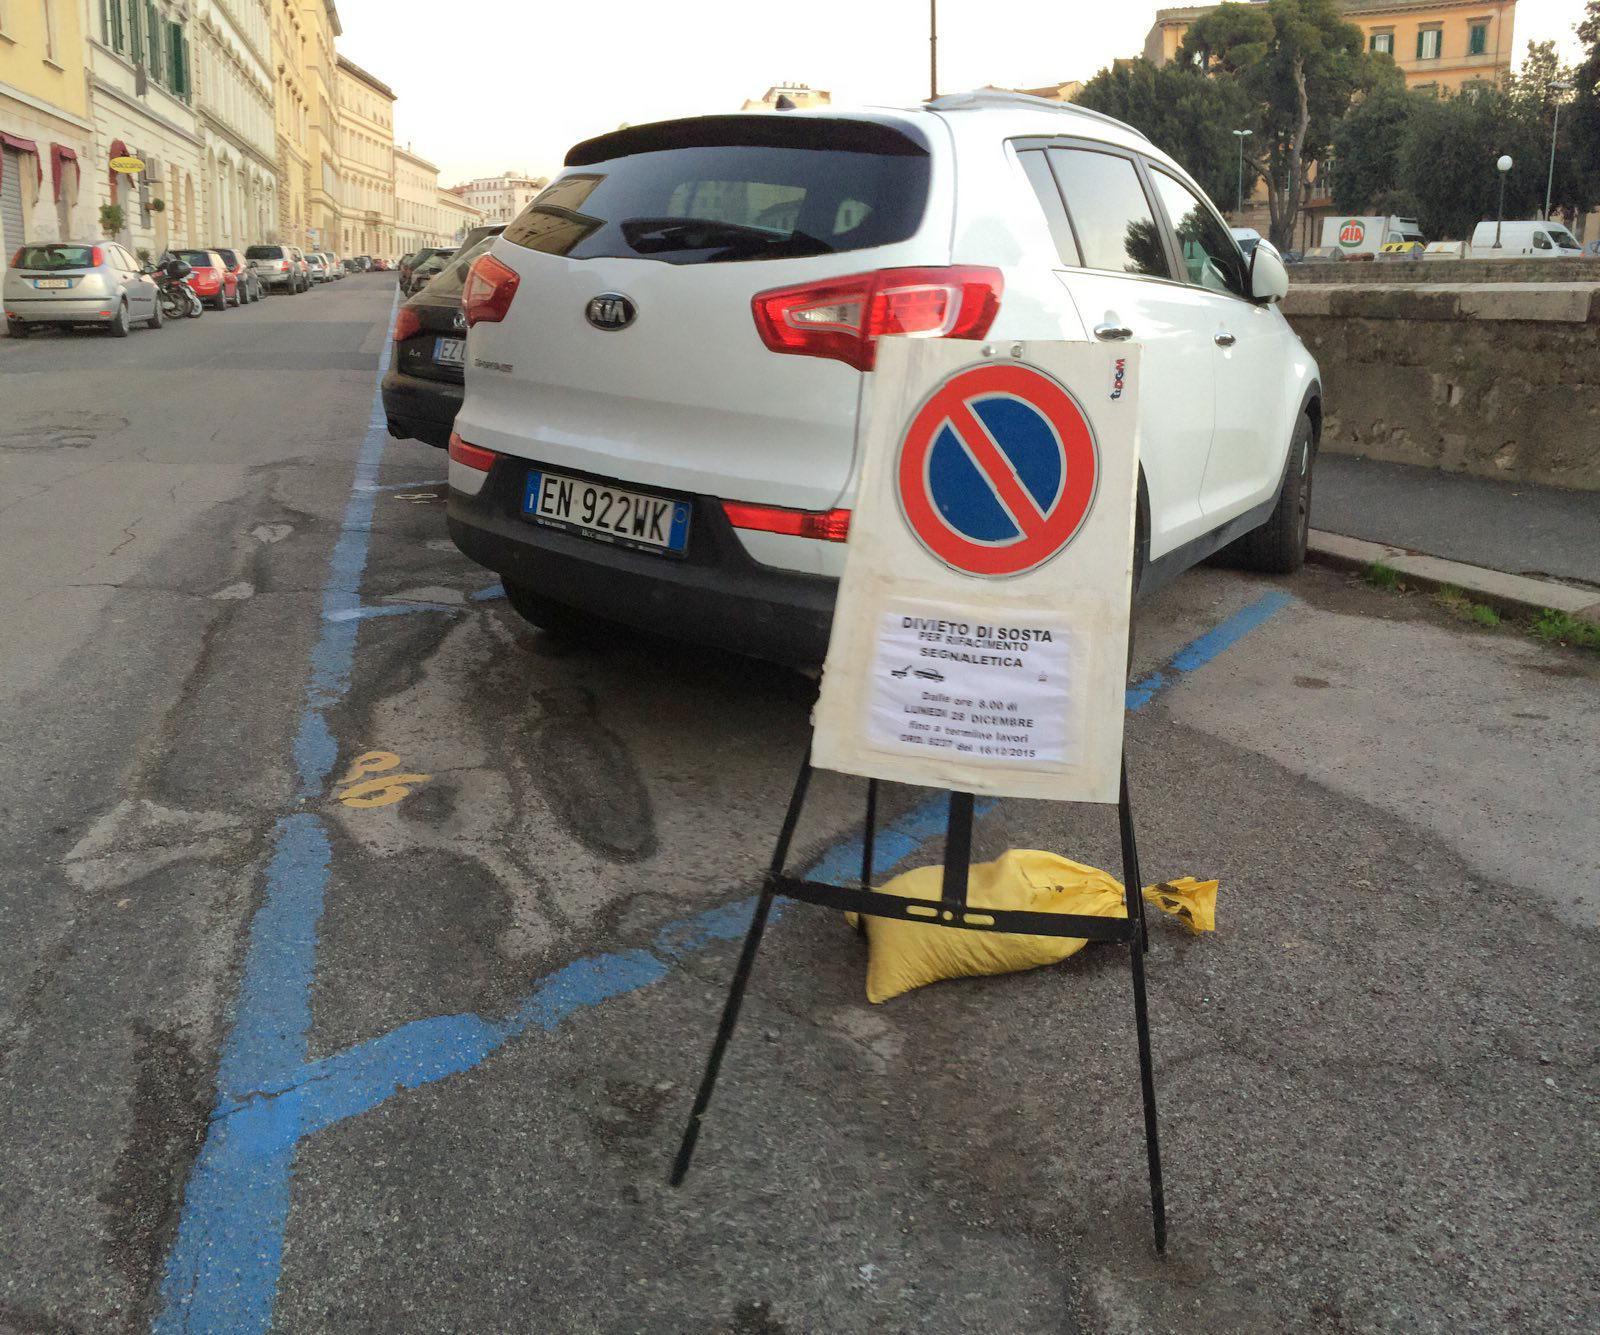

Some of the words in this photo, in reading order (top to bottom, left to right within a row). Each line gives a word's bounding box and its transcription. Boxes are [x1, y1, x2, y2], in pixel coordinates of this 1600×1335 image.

[590, 299, 626, 323] KIA
[540, 477, 574, 518] EN
[581, 487, 668, 542] 922WK
[902, 616, 969, 636] DIVIETO
[976, 625, 992, 639] DI
[997, 627, 1053, 643] SOSTA
[918, 631, 942, 642] PER
[945, 635, 1029, 652] RIFACIMENTO
[919, 647, 1024, 668] SEGNALETICA
[971, 713, 1034, 728] DICEMBRE
[996, 731, 1029, 744] lavori
